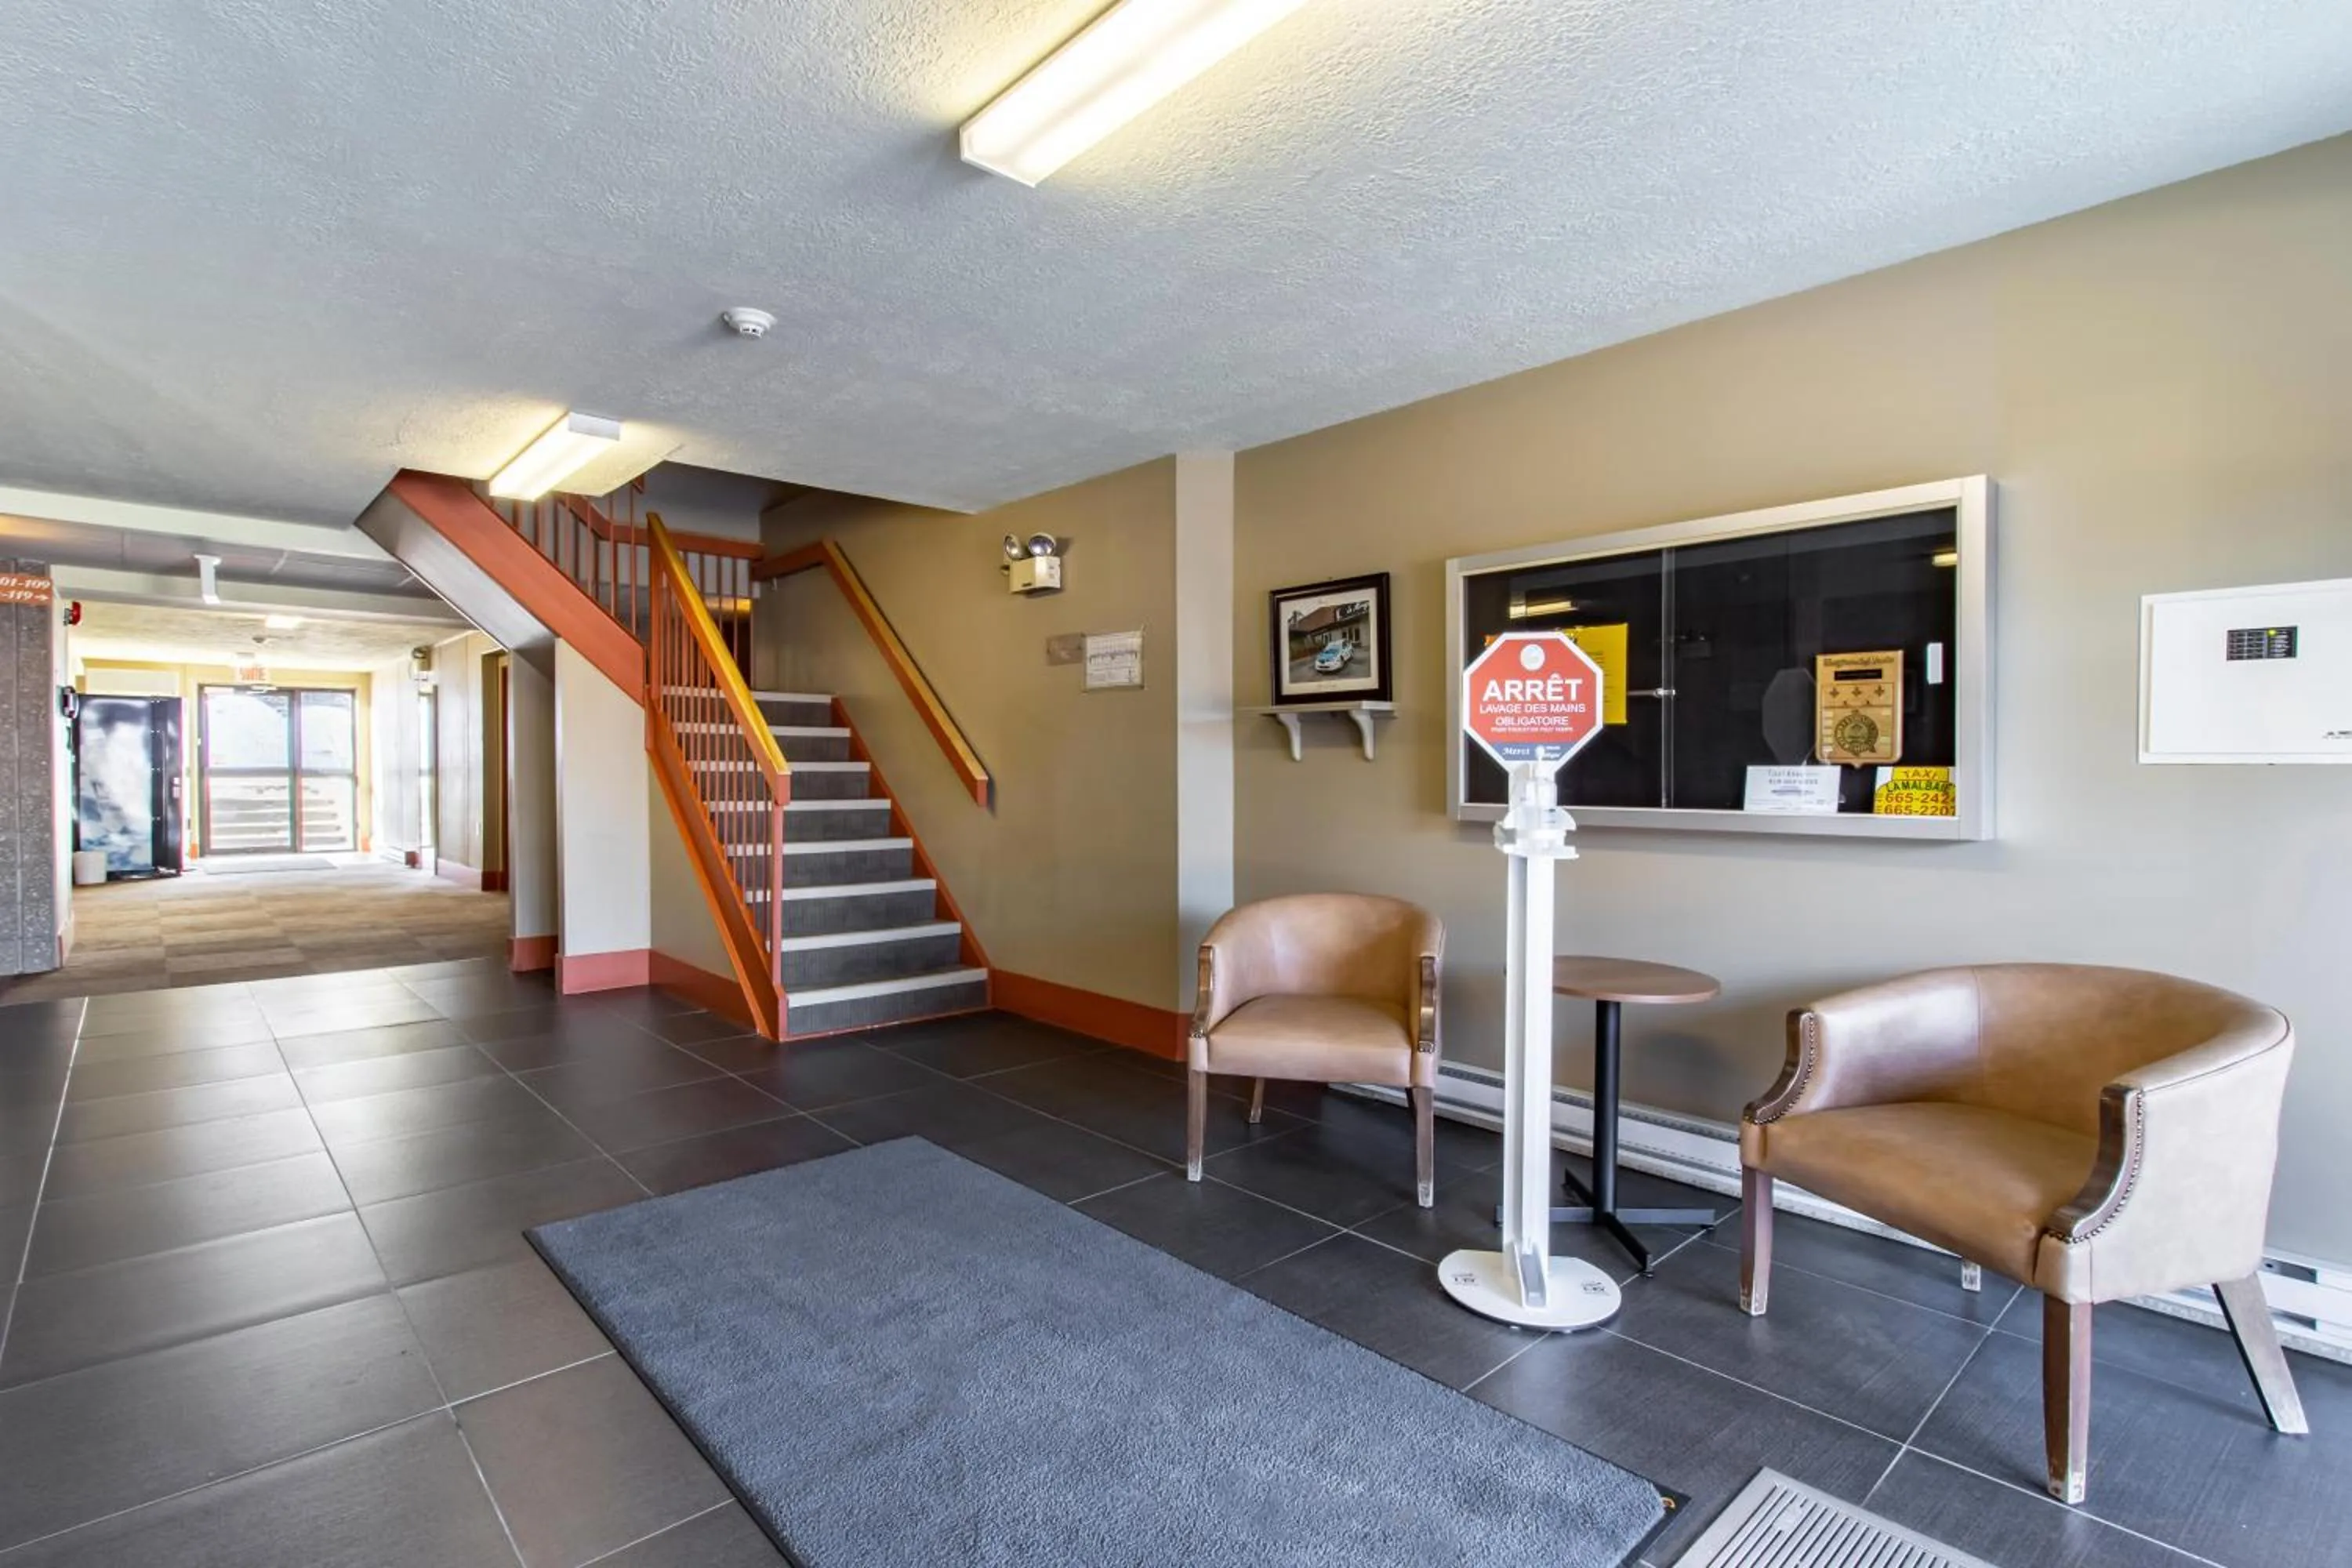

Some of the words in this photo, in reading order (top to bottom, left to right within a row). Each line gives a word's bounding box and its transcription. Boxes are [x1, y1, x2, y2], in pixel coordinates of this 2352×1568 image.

[1483, 673, 1583, 702] ARRÊT
[1479, 704, 1522, 714] LAVAGE
[1525, 704, 1548, 713] DES
[1550, 703, 1586, 713] MAINS
[1495, 716, 1569, 726] OBLIGATOIRE
